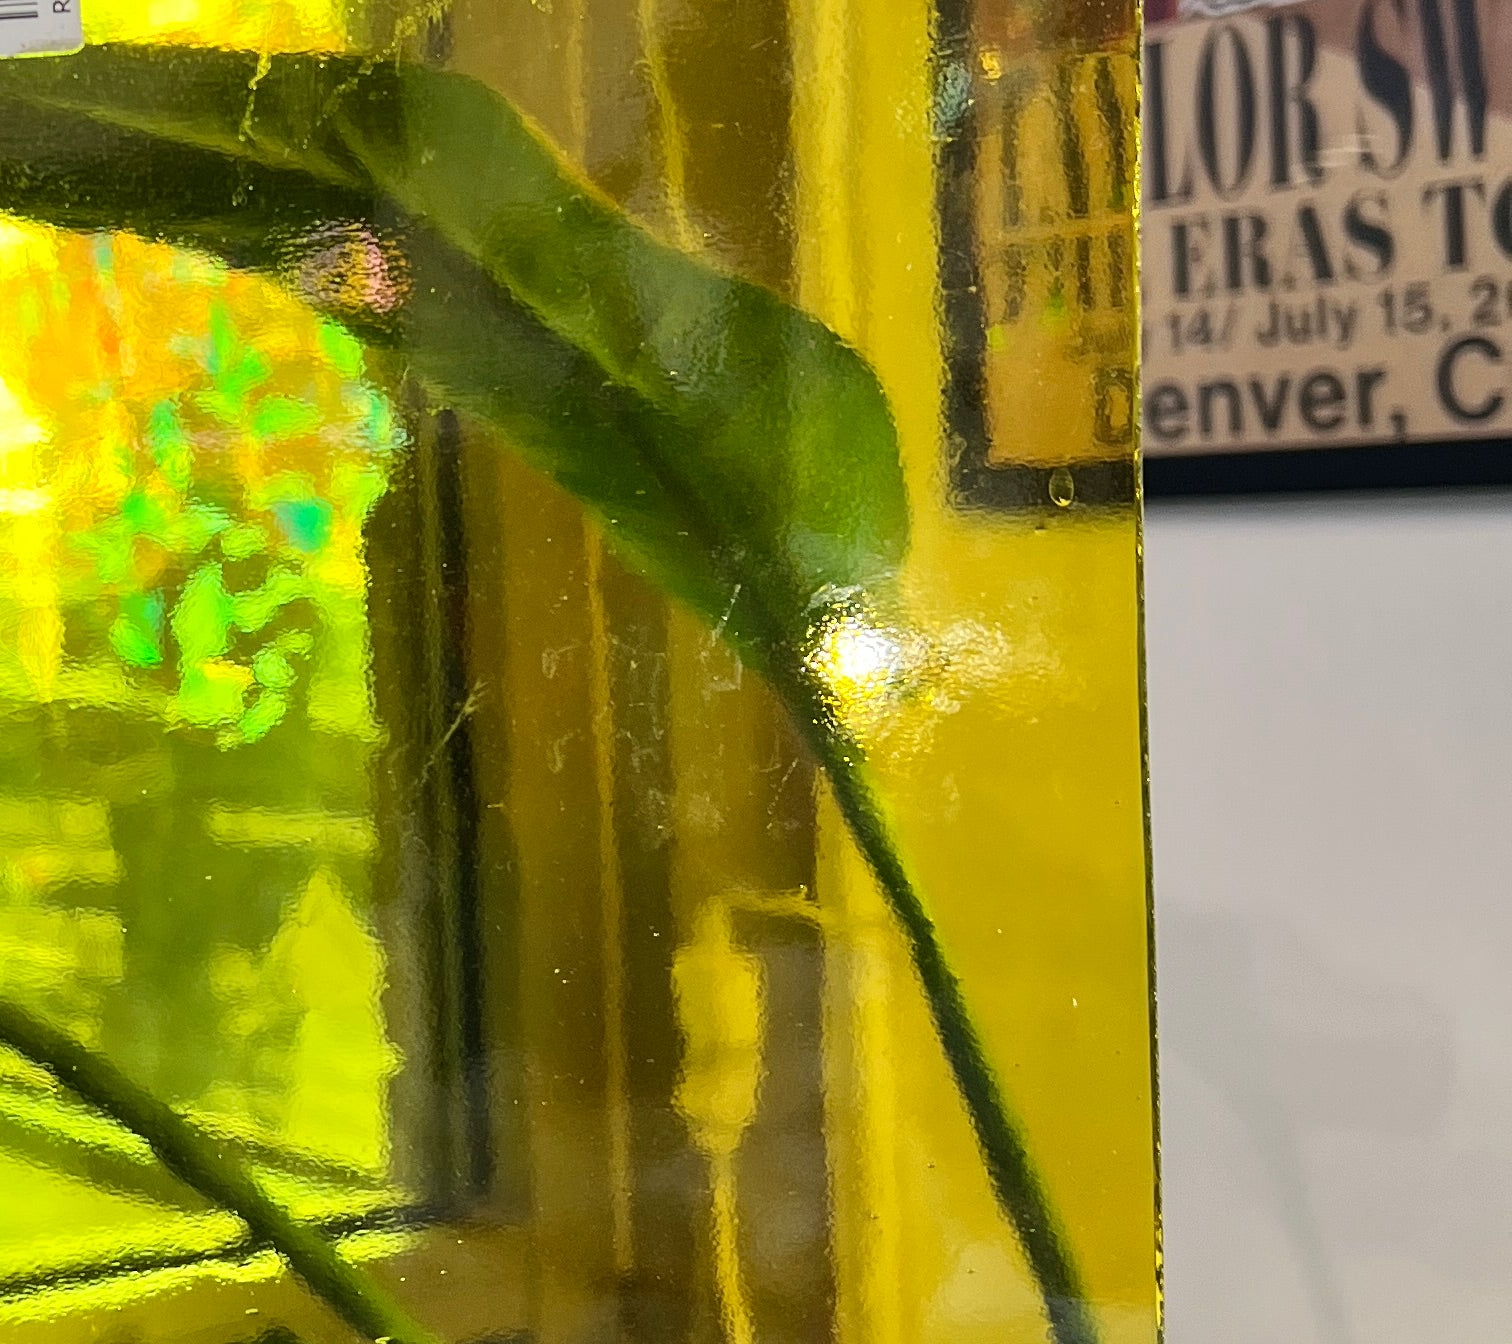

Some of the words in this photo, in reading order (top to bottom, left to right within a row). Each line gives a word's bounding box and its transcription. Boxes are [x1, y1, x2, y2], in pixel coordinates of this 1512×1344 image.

[1170, 187, 1397, 301] ERAS
[1421, 175, 1512, 274] T
[1255, 293, 1360, 351] July
[1466, 271, 1512, 330] 2
